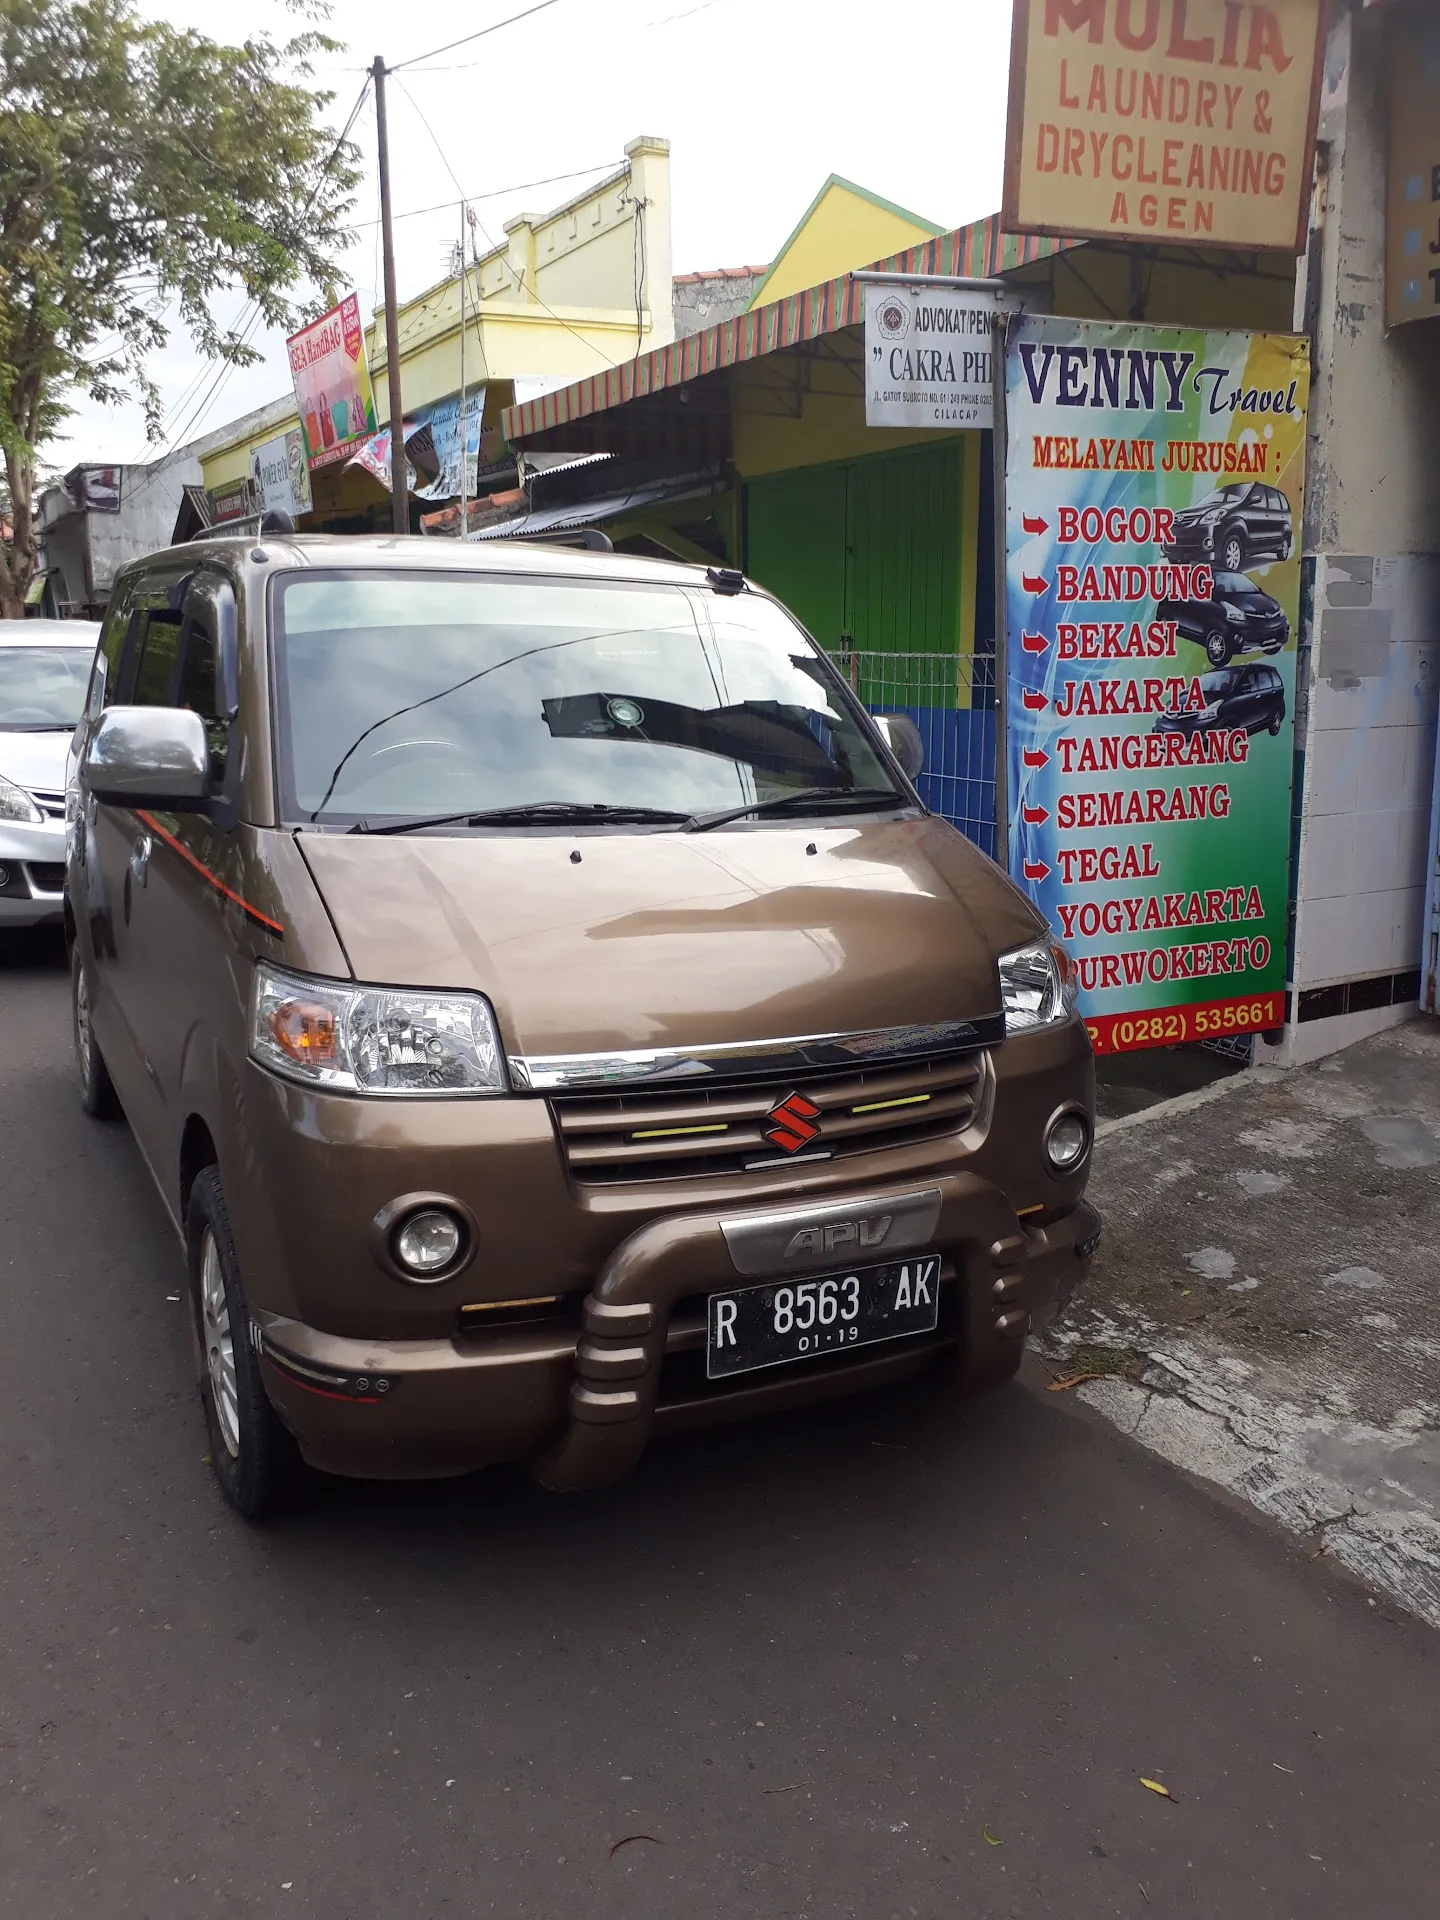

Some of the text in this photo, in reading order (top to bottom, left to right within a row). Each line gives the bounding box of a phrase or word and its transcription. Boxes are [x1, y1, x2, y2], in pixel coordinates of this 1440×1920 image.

[1059, 58, 1273, 134] LAUNDRY &
[1036, 122, 1286, 197] DRYCLEANING
[1110, 191, 1214, 232] AGEN
[915, 306, 996, 335] ADVOKAT/PEN
[889, 347, 956, 382] CAKRA
[1019, 344, 1297, 415] VENNY Travel
[883, 391, 901, 402] GATOT
[960, 394, 979, 405] PHONE
[934, 408, 978, 420] CILACAP
[1032, 435, 1156, 472] MELAYANI
[1161, 440, 1268, 474] JURUSAN
[1057, 507, 1176, 544] BOGOR
[1057, 565, 1214, 602] BANDUNG
[1057, 622, 1178, 660] BEKASI
[1055, 677, 1207, 717] JAKARTA
[1057, 729, 1249, 773] TANGERANG
[1057, 784, 1230, 829] SEMARANG
[1057, 843, 1160, 885] TEGAL
[1057, 886, 1265, 939] YOGYAKARTA
[1073, 936, 1271, 991] URWOKERTO
[1111, 1013, 1187, 1051] (0282)
[1195, 1001, 1275, 1033] 535661
[784, 1215, 892, 1259] APV
[716, 1261, 935, 1349] R 8563 AK
